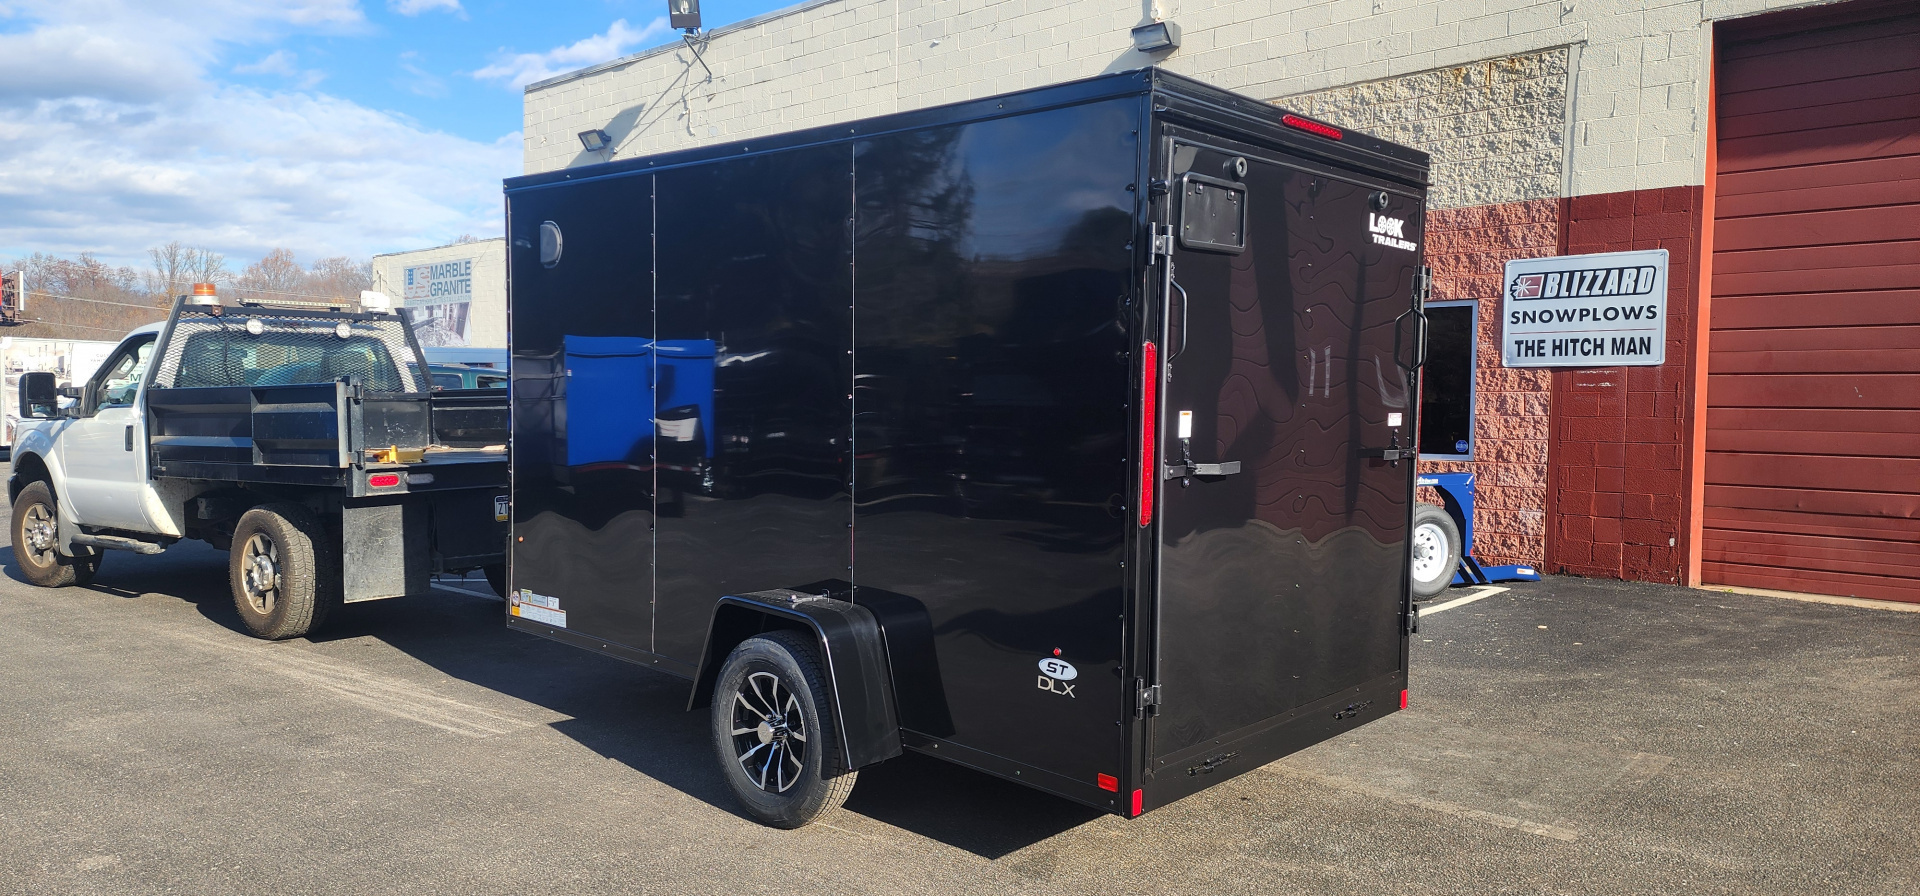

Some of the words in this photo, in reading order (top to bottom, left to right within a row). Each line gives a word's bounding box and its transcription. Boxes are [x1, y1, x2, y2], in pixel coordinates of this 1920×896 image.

[1369, 212, 1404, 239] LOOK
[1372, 233, 1418, 252] TRAILERS
[430, 260, 471, 280] MARBLE
[430, 279, 471, 297] GRANITE
[1543, 266, 1656, 299] BLIZZARD
[1510, 305, 1658, 325] SNOWPLOWS
[1514, 339, 1546, 358] THE
[1551, 338, 1605, 357] HITCH
[1611, 336, 1652, 356] MAN
[1046, 661, 1069, 676] ST
[1037, 675, 1076, 699] DLX
